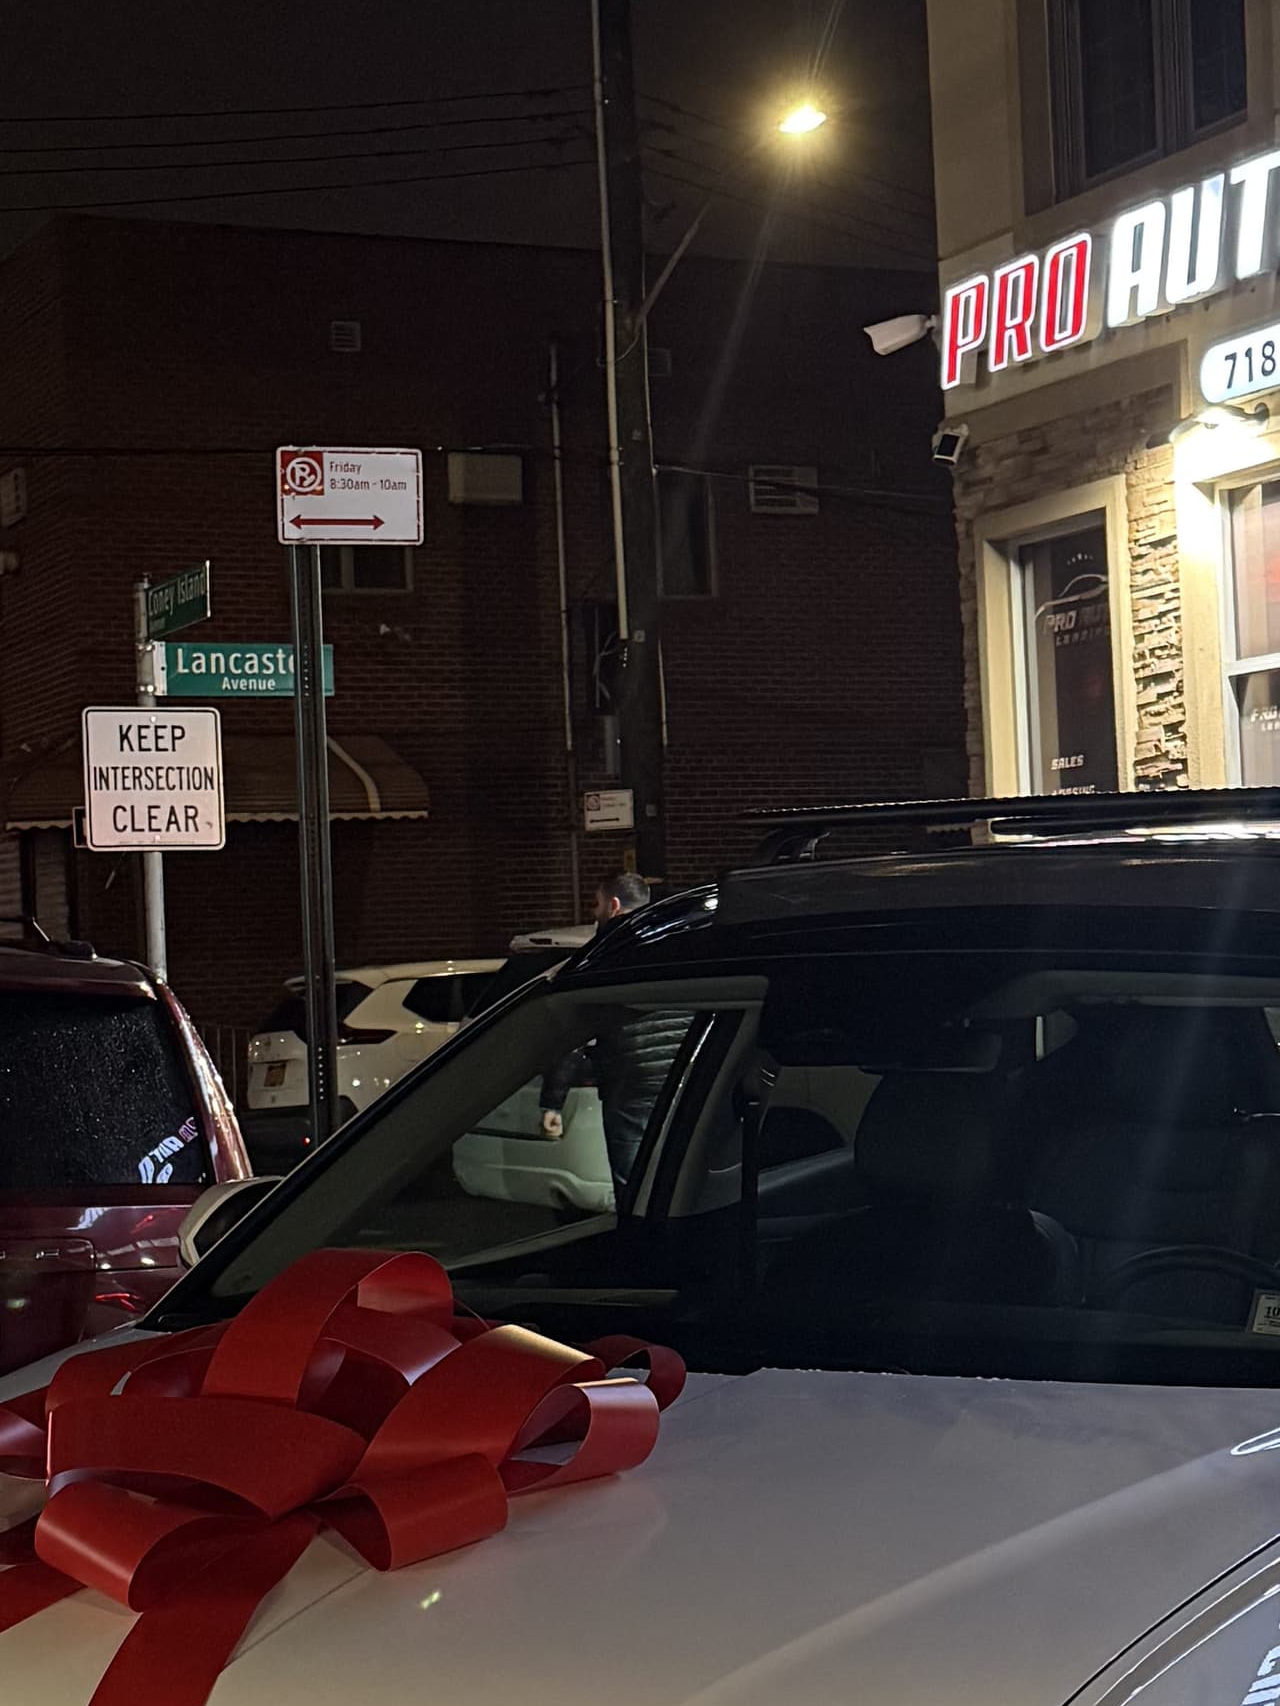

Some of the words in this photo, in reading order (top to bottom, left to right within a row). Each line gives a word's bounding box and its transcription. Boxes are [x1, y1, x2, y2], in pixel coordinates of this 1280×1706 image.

[940, 232, 1092, 390] PRO
[329, 461, 362, 475] Friday
[329, 478, 369, 492] 8:30am
[379, 479, 407, 492] 10am
[222, 676, 276, 691] Avenue
[119, 725, 186, 753] KEEP
[1051, 755, 1083, 770] SALES
[93, 766, 215, 791] INTERSECTION
[112, 805, 200, 833] CLEAR
